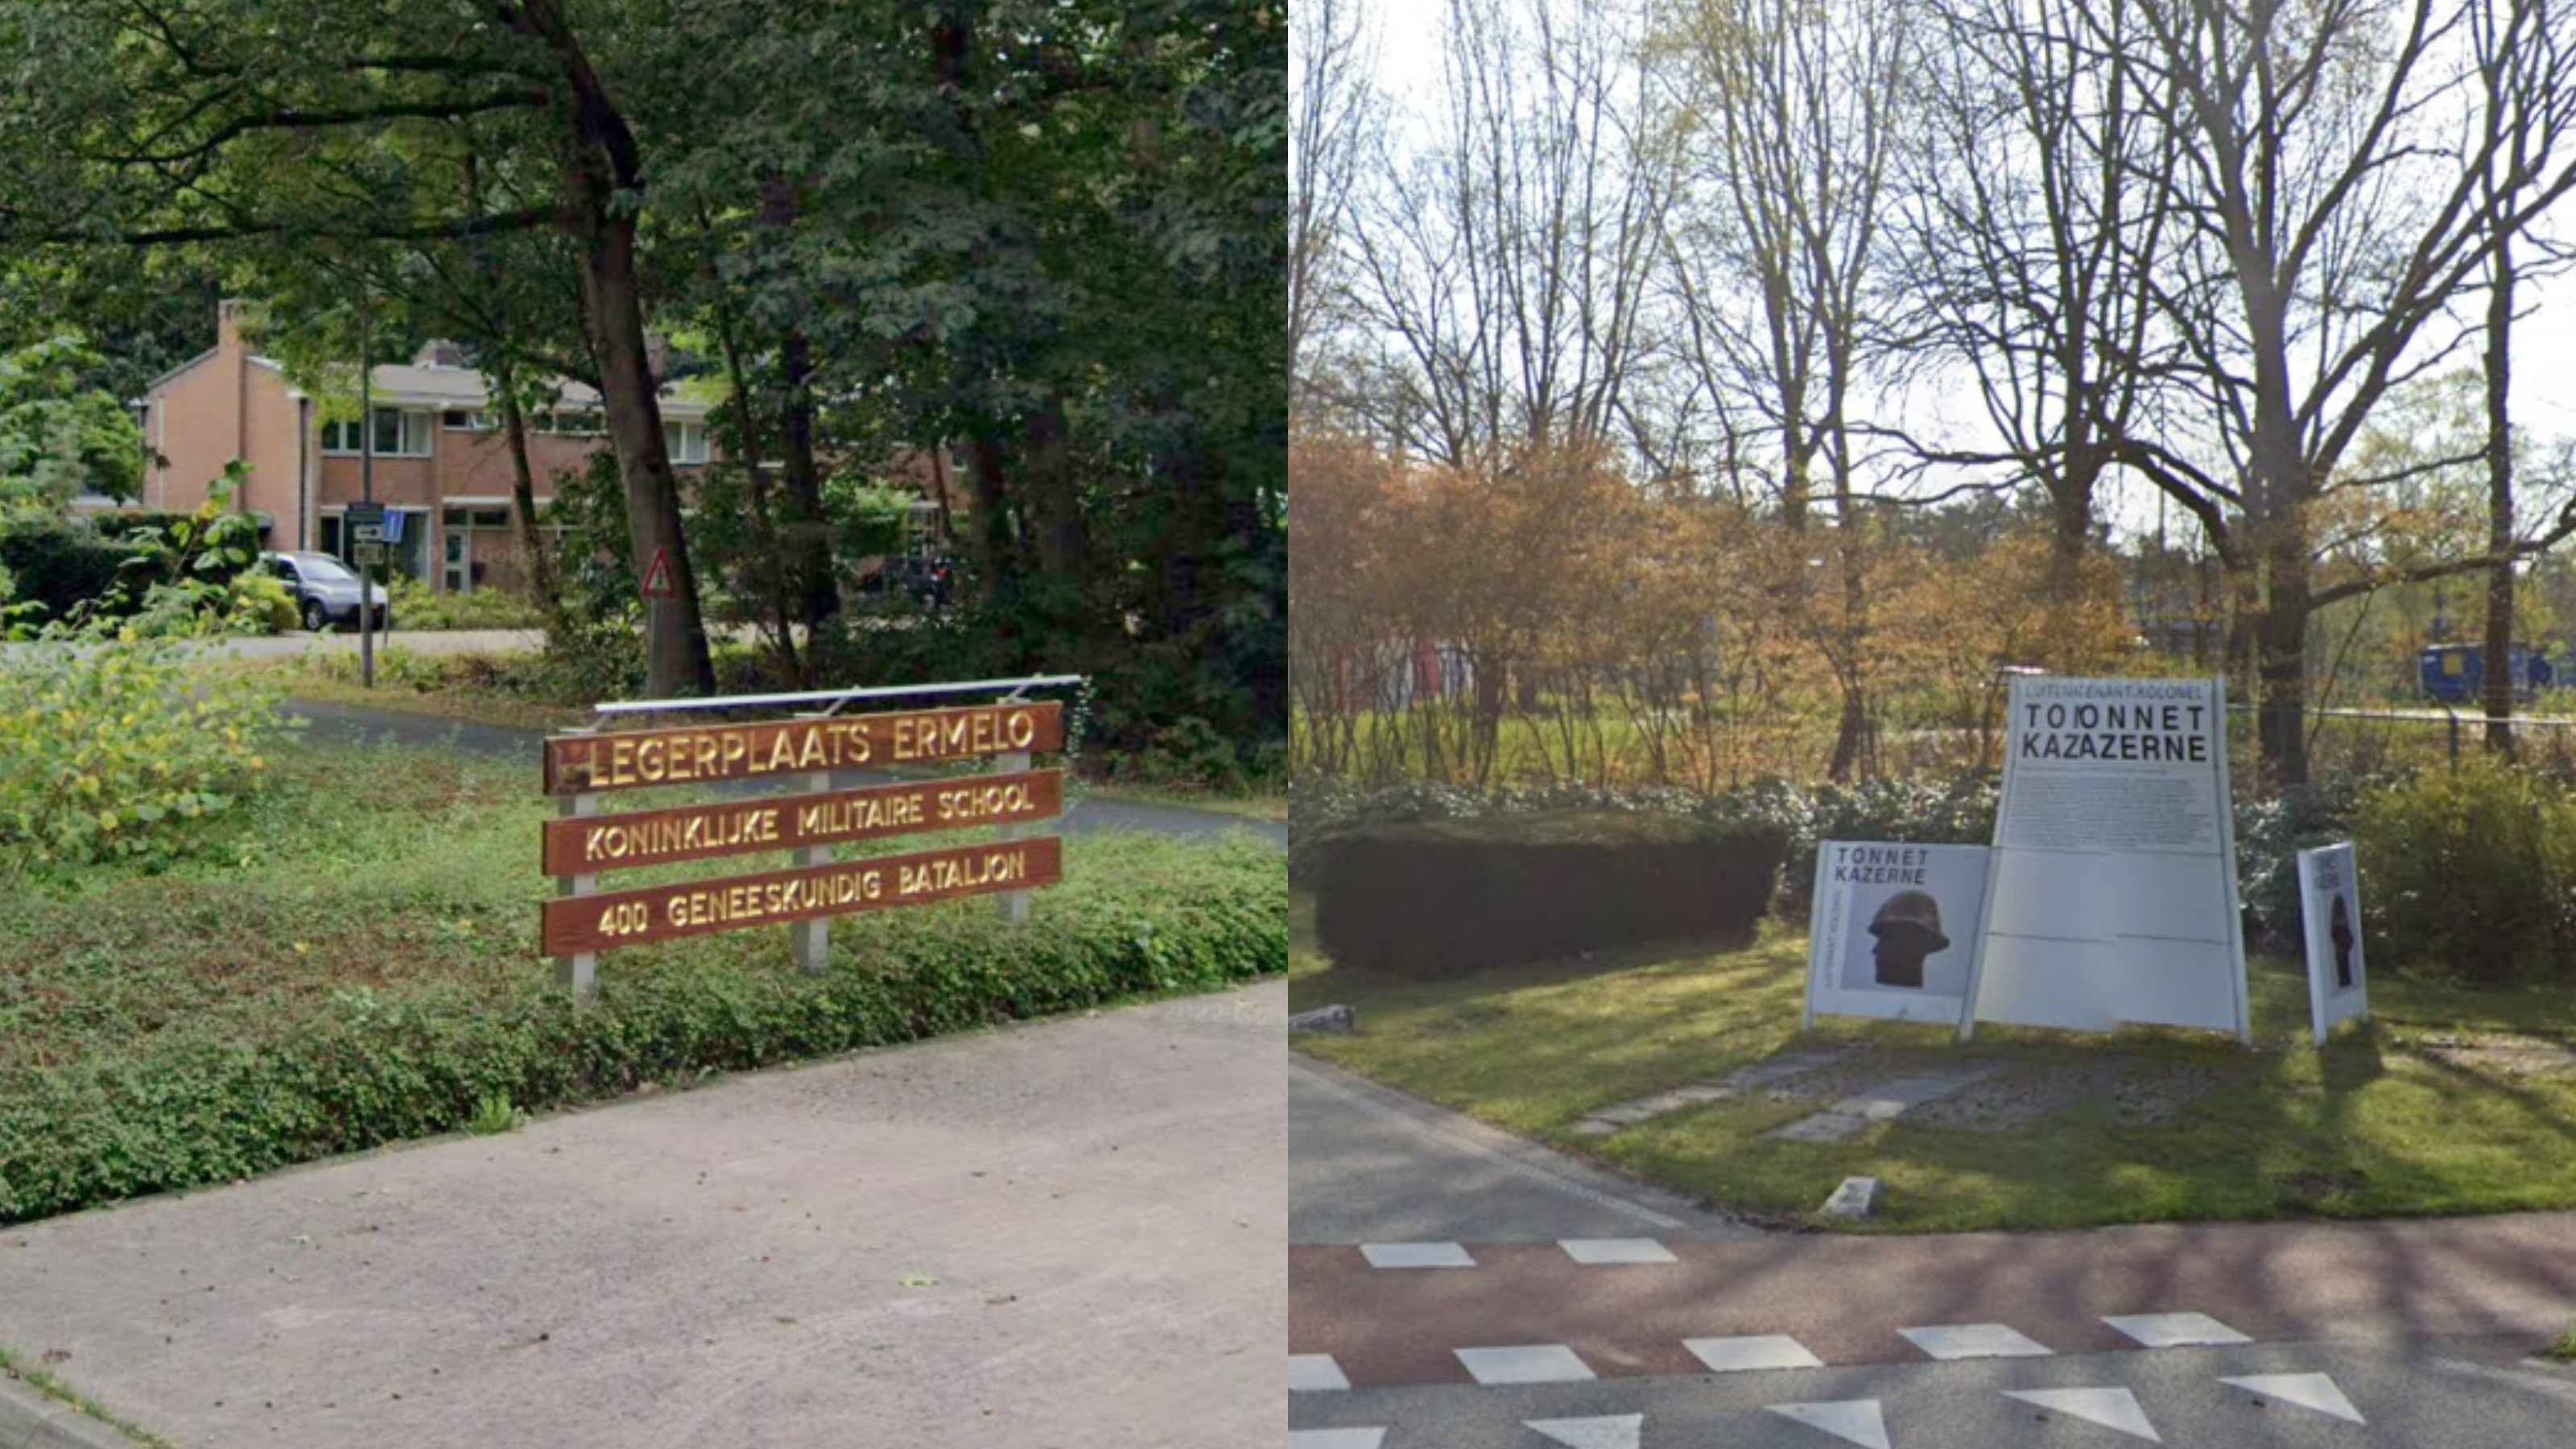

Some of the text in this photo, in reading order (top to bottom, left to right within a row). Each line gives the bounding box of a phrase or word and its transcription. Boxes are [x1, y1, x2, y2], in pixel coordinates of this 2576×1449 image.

[588, 709, 1035, 787] LEGERPLAATS ERMELO
[585, 782, 1036, 861] KONINKLIJKE MILITAIRE SCHOOL
[1838, 848, 1929, 866] TONNET
[597, 850, 1026, 937] 400 GENEESKUNDIG BATALJON
[1835, 865, 1926, 886] KAZERNE
